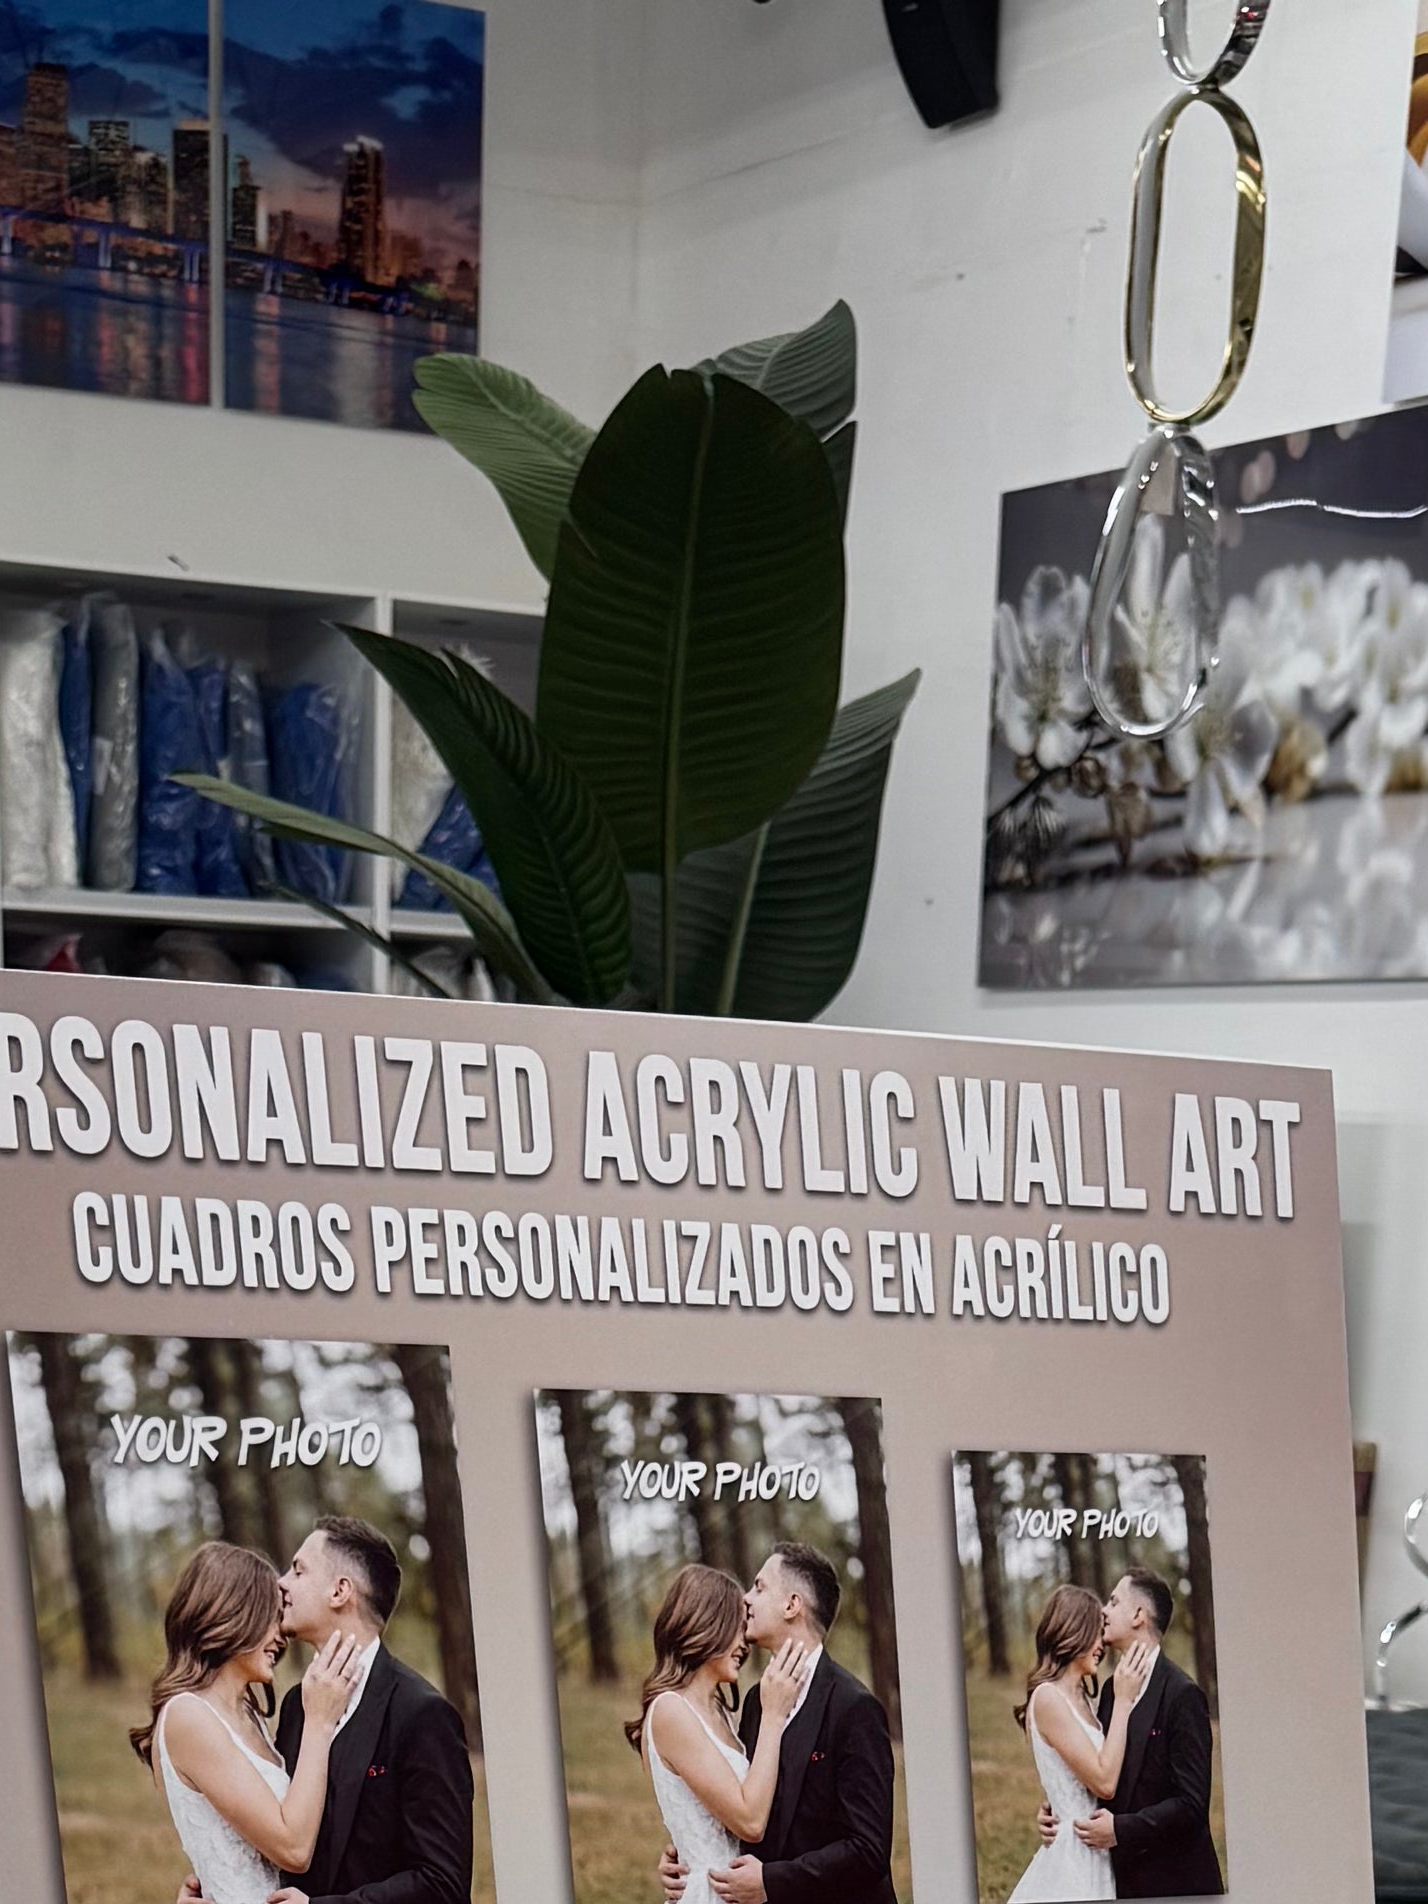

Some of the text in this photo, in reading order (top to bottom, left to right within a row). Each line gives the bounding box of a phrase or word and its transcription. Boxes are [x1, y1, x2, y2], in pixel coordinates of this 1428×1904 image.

[583, 1049, 919, 1198] ACRYLIC
[937, 1074, 1148, 1211] WALL
[1168, 1092, 1301, 1219] ART
[72, 1190, 1171, 1325] CUADROS PERSONALIZADOS EN ACRÍLICO
[109, 1412, 383, 1469] YOUR PHOTO
[620, 1458, 821, 1503] YOUR PHOTO
[1014, 1507, 1160, 1541] YOUR PHOTO
